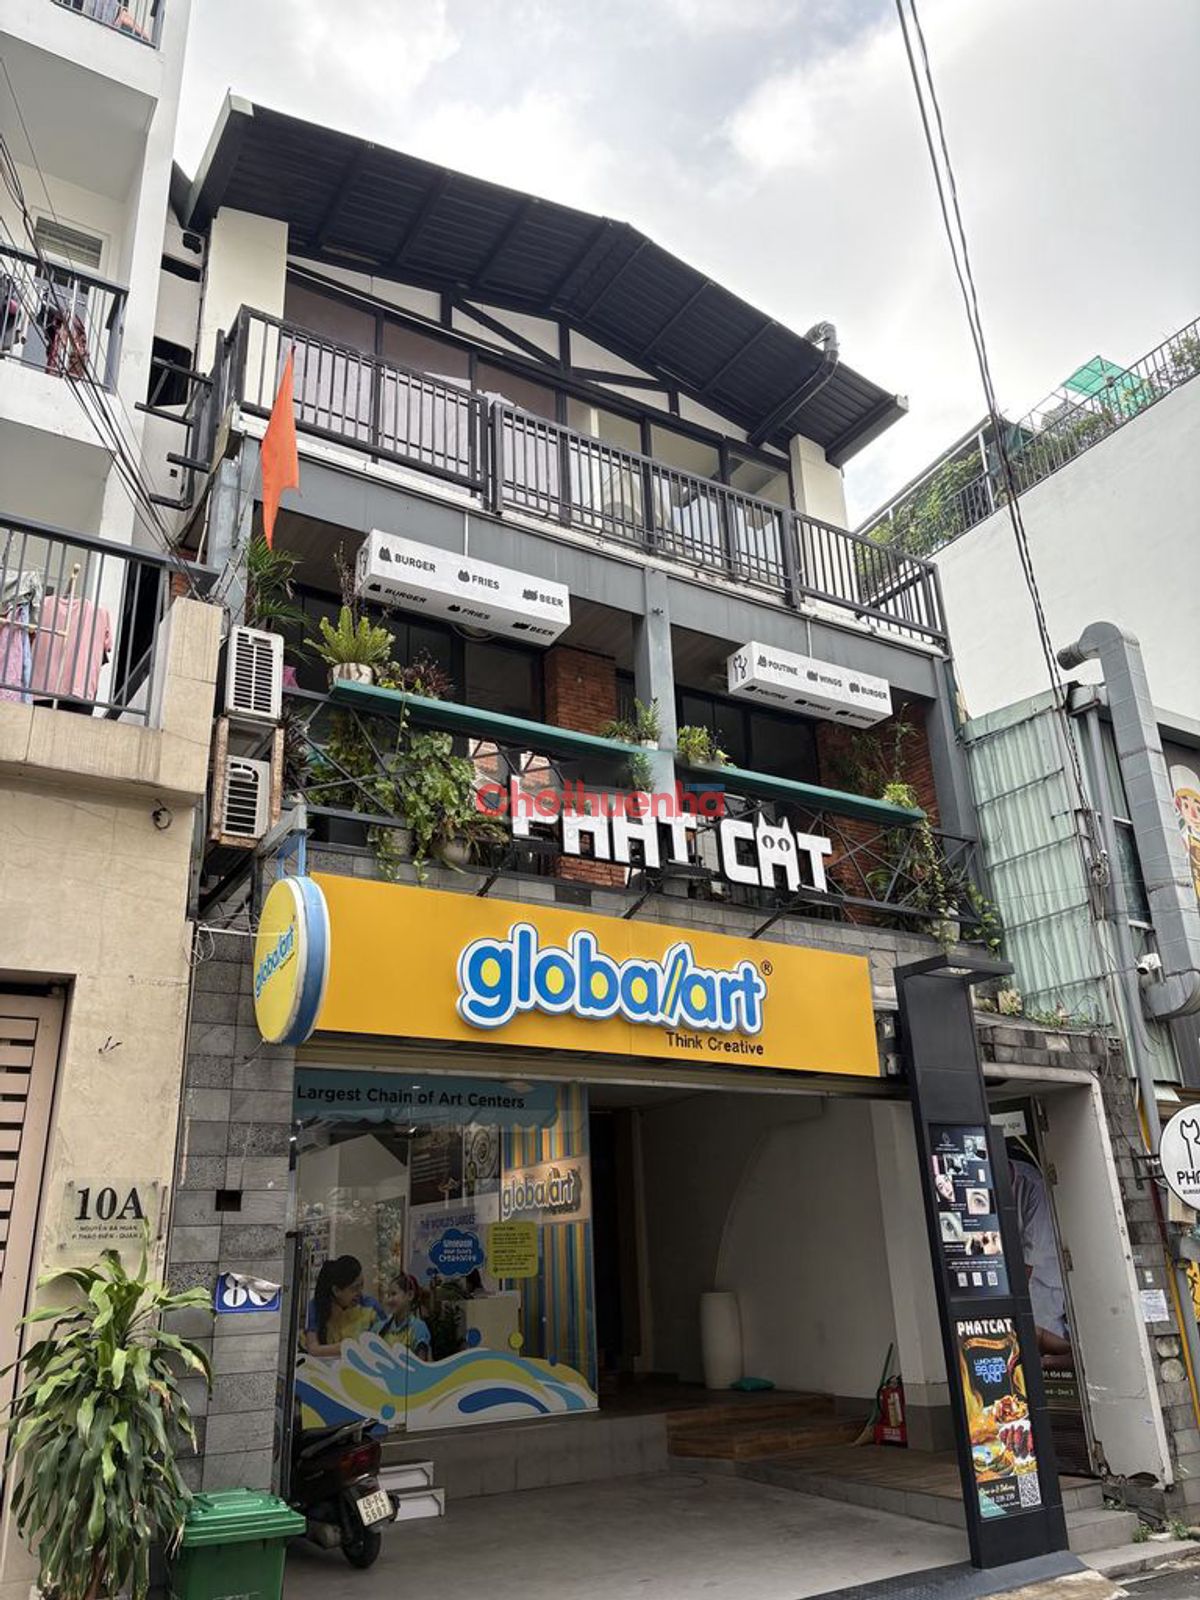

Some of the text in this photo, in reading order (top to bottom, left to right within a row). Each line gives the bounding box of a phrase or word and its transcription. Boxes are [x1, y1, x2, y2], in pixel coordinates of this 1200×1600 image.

[394, 553, 564, 608] BURGER FRIES BEER
[384, 588, 555, 637] BURGER FRIES BEER
[767, 660, 888, 700] POUTINE WINGS BURGER
[720, 811, 833, 893] CAT
[665, 1031, 765, 1056] Think Creative
[297, 1084, 525, 1109] Largest Chain of Art Centers
[75, 1187, 145, 1221] 10A
[957, 1318, 1013, 1336] PHATCAT
